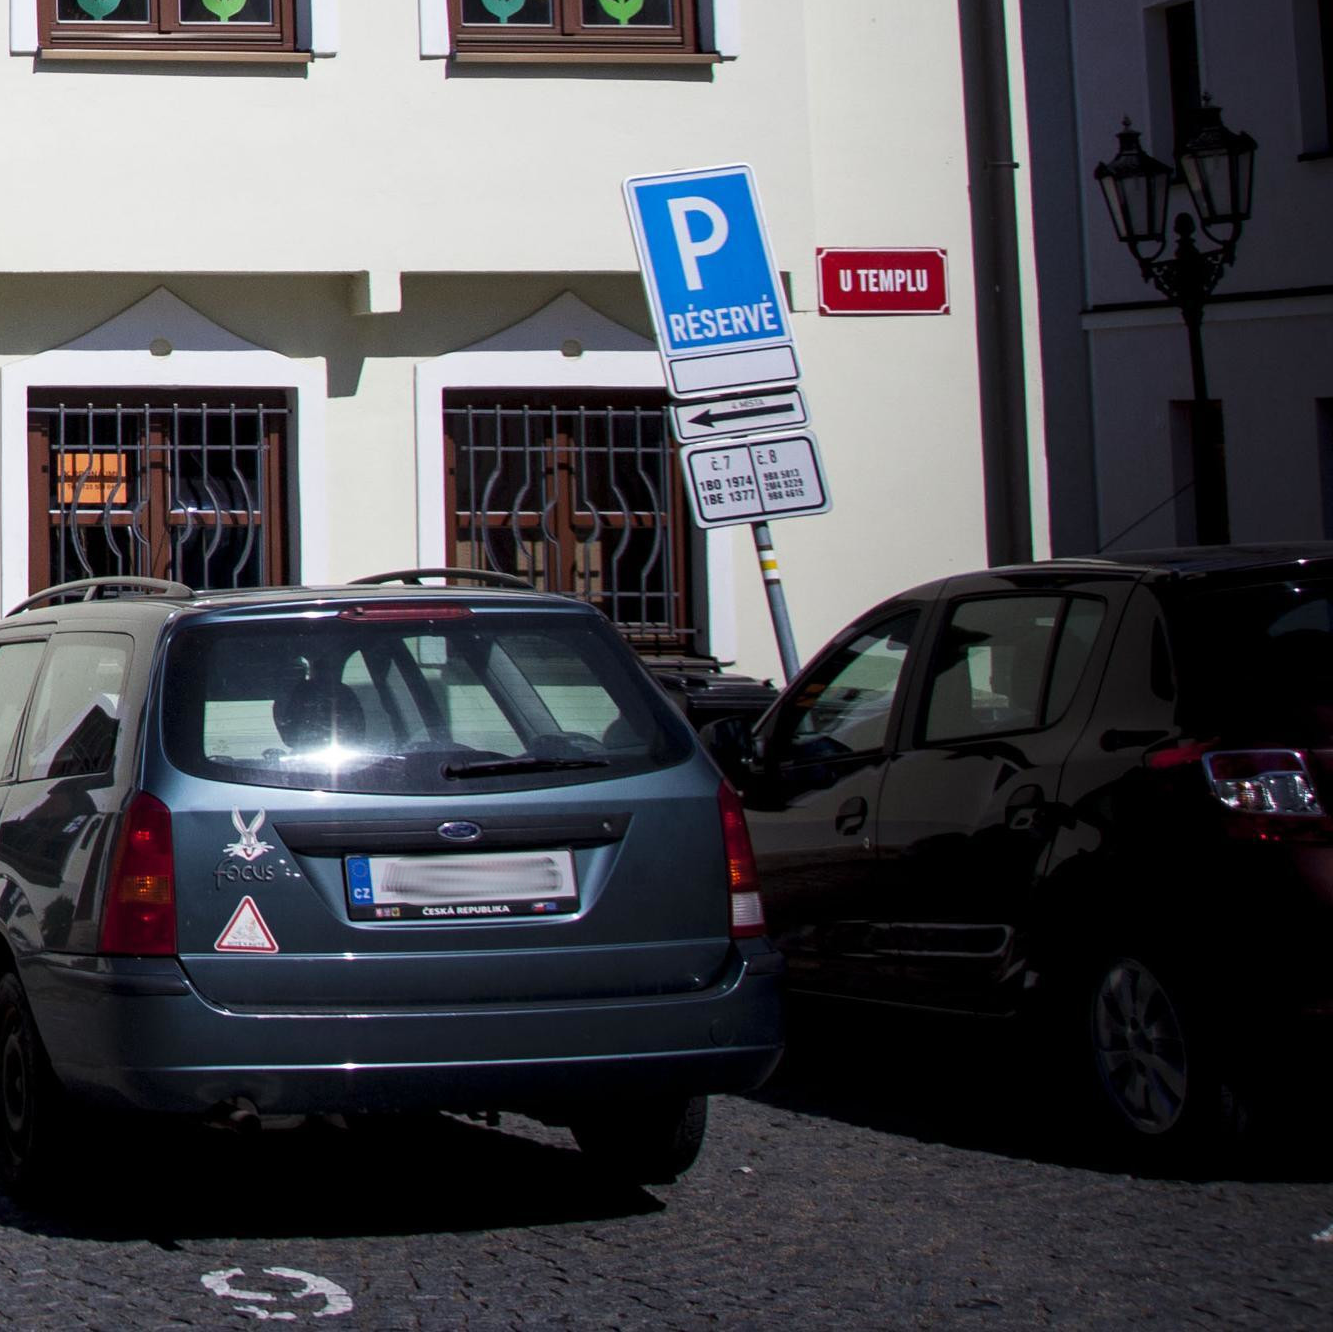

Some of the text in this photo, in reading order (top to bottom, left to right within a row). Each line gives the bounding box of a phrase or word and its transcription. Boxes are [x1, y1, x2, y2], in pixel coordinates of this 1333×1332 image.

[667, 196, 729, 291] P
[839, 269, 928, 293] U TEMPLU
[670, 295, 778, 342] RÉSERVÉ
[726, 475, 754, 489] 1974
[354, 888, 371, 899] CZ
[422, 904, 510, 916] ČESKÁ REPUBLIKA
